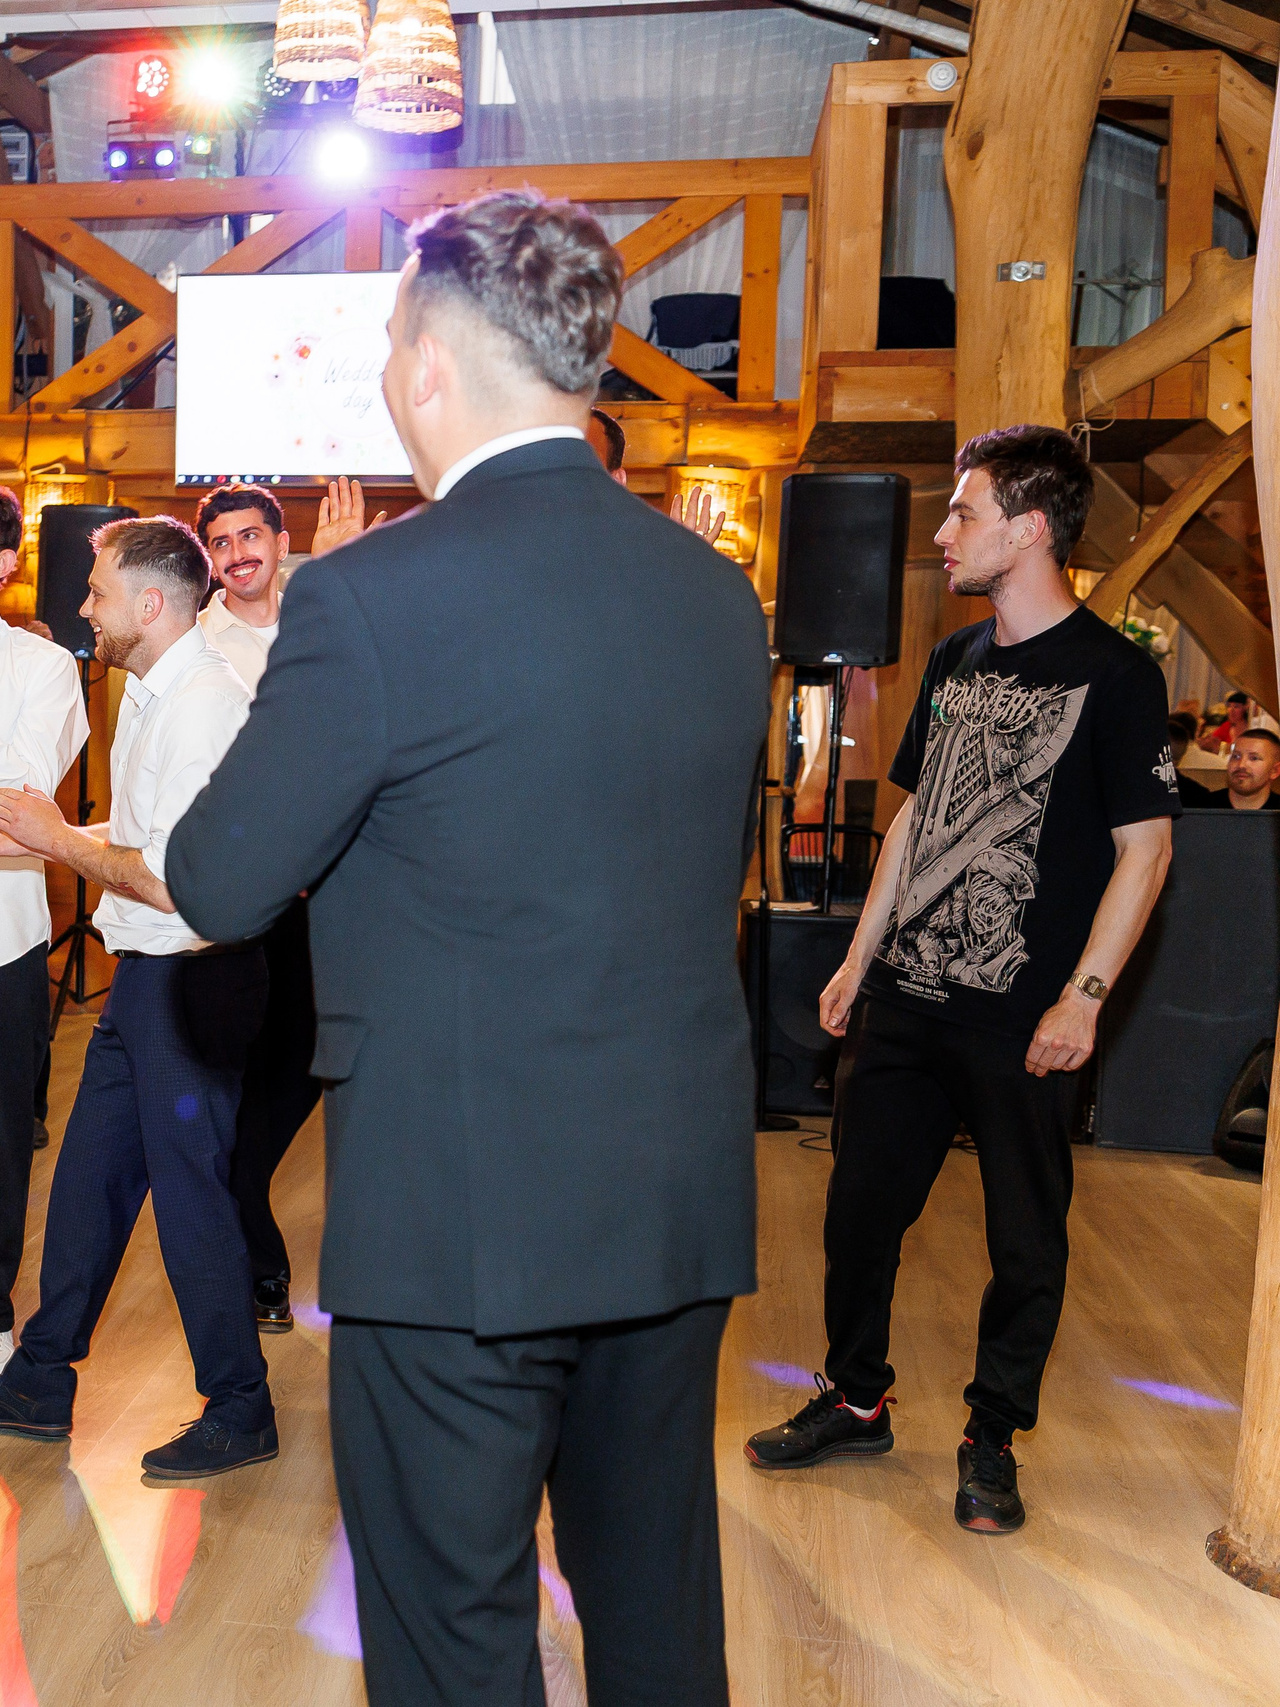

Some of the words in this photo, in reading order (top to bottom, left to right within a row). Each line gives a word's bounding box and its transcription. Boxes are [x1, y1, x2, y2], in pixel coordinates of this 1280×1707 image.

[343, 386, 373, 419] day
[896, 979, 925, 992] DESIGNED
[925, 987, 933, 995] IN
[933, 989, 950, 999] HELL
